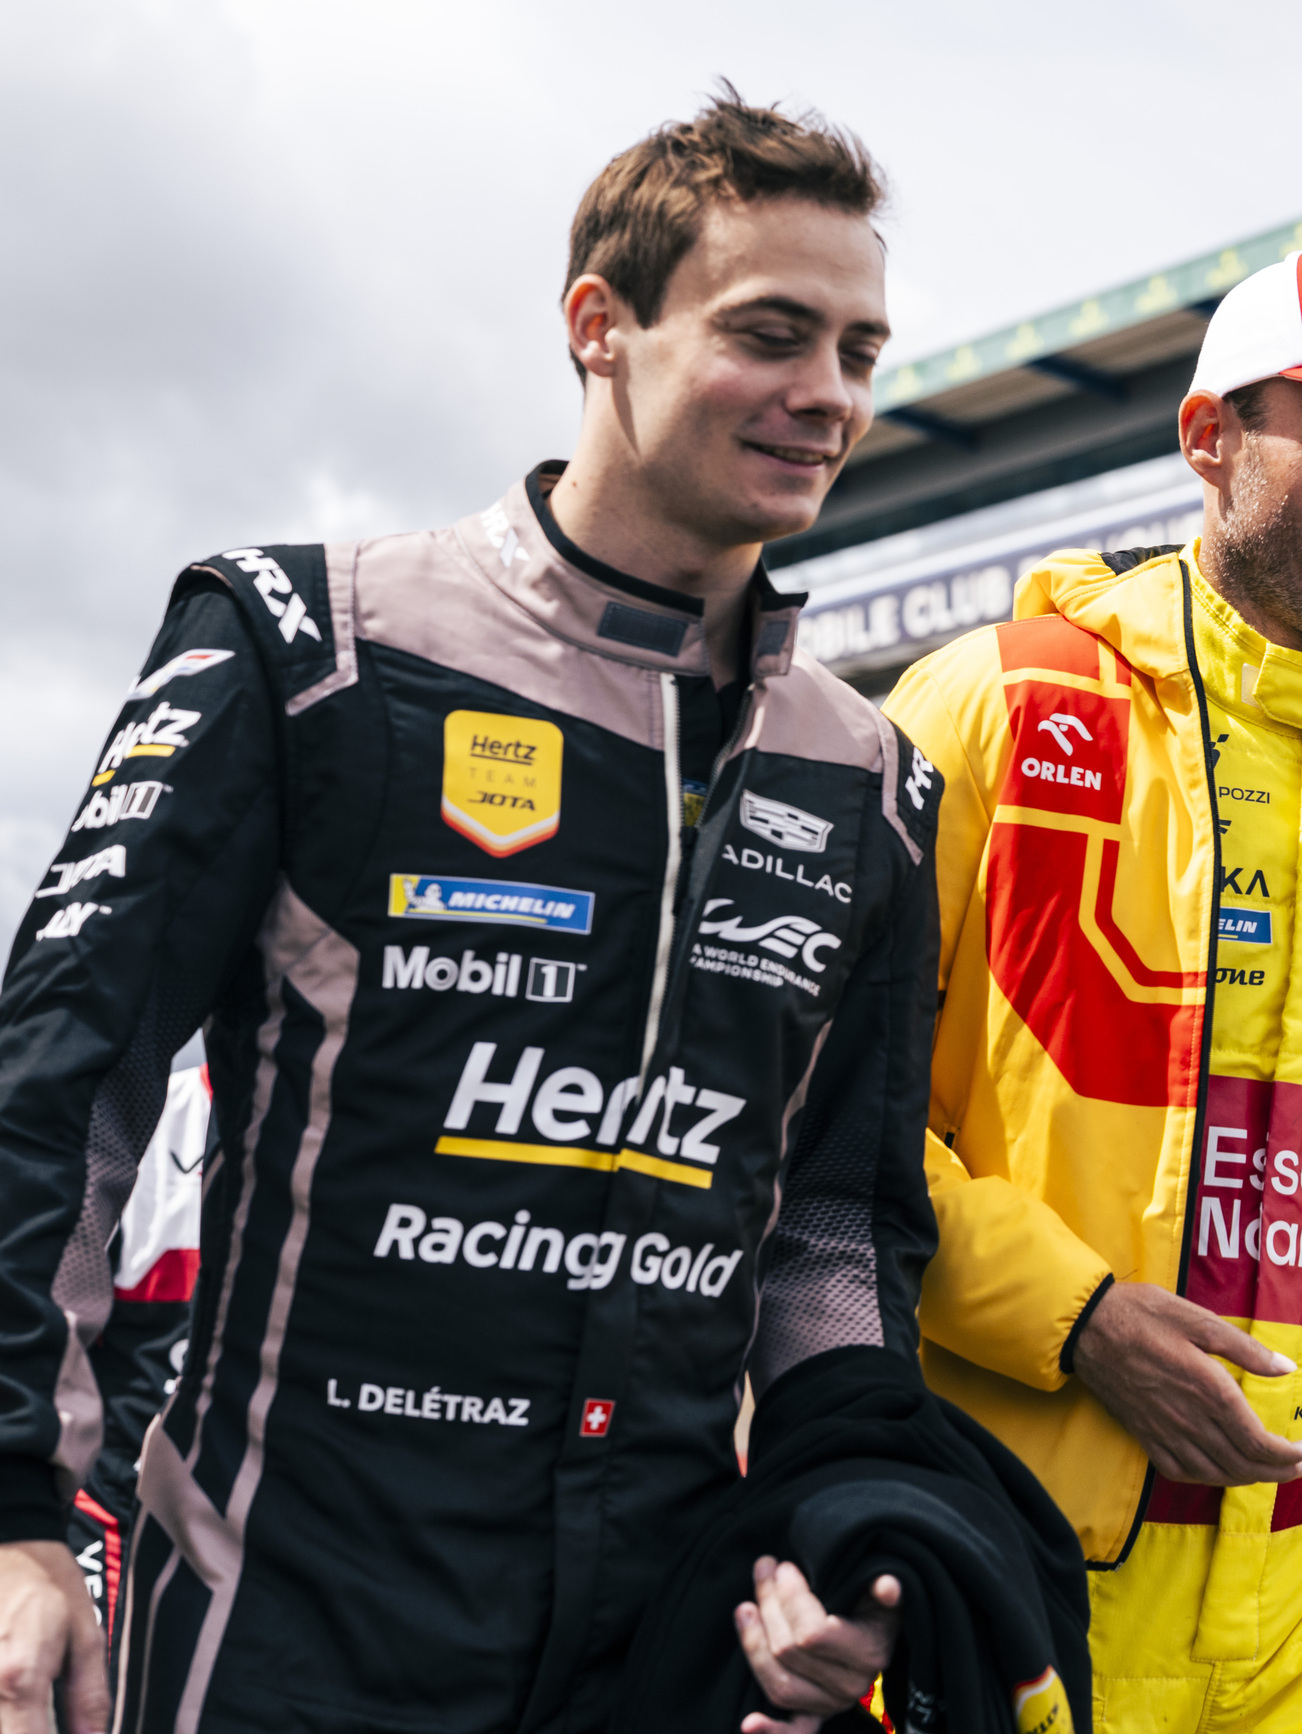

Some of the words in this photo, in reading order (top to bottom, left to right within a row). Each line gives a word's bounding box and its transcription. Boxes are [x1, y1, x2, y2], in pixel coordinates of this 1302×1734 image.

[222, 548, 323, 643] HRX
[902, 565, 1012, 639] CLUB
[97, 701, 202, 773] Hrtz
[470, 734, 538, 762] Hertz
[468, 766, 537, 789] TEAM
[1021, 757, 1102, 791] ORLEN
[466, 791, 537, 812] JOTA
[1218, 786, 1270, 804] POZZI
[722, 844, 853, 904] ADILLAC
[447, 891, 576, 920] MICHELIN
[698, 898, 842, 973] WEC
[1218, 918, 1258, 934] ELIN
[382, 945, 524, 998] Mobil
[689, 956, 784, 988] AMPIONSHIP
[703, 945, 759, 968] WORLD
[1214, 967, 1266, 986] one
[442, 1041, 747, 1165] Hertz
[373, 1203, 627, 1290] Racing
[630, 1232, 744, 1298] Gold
[327, 1378, 351, 1408] L.
[358, 1383, 531, 1425] DELÉTRAZ
